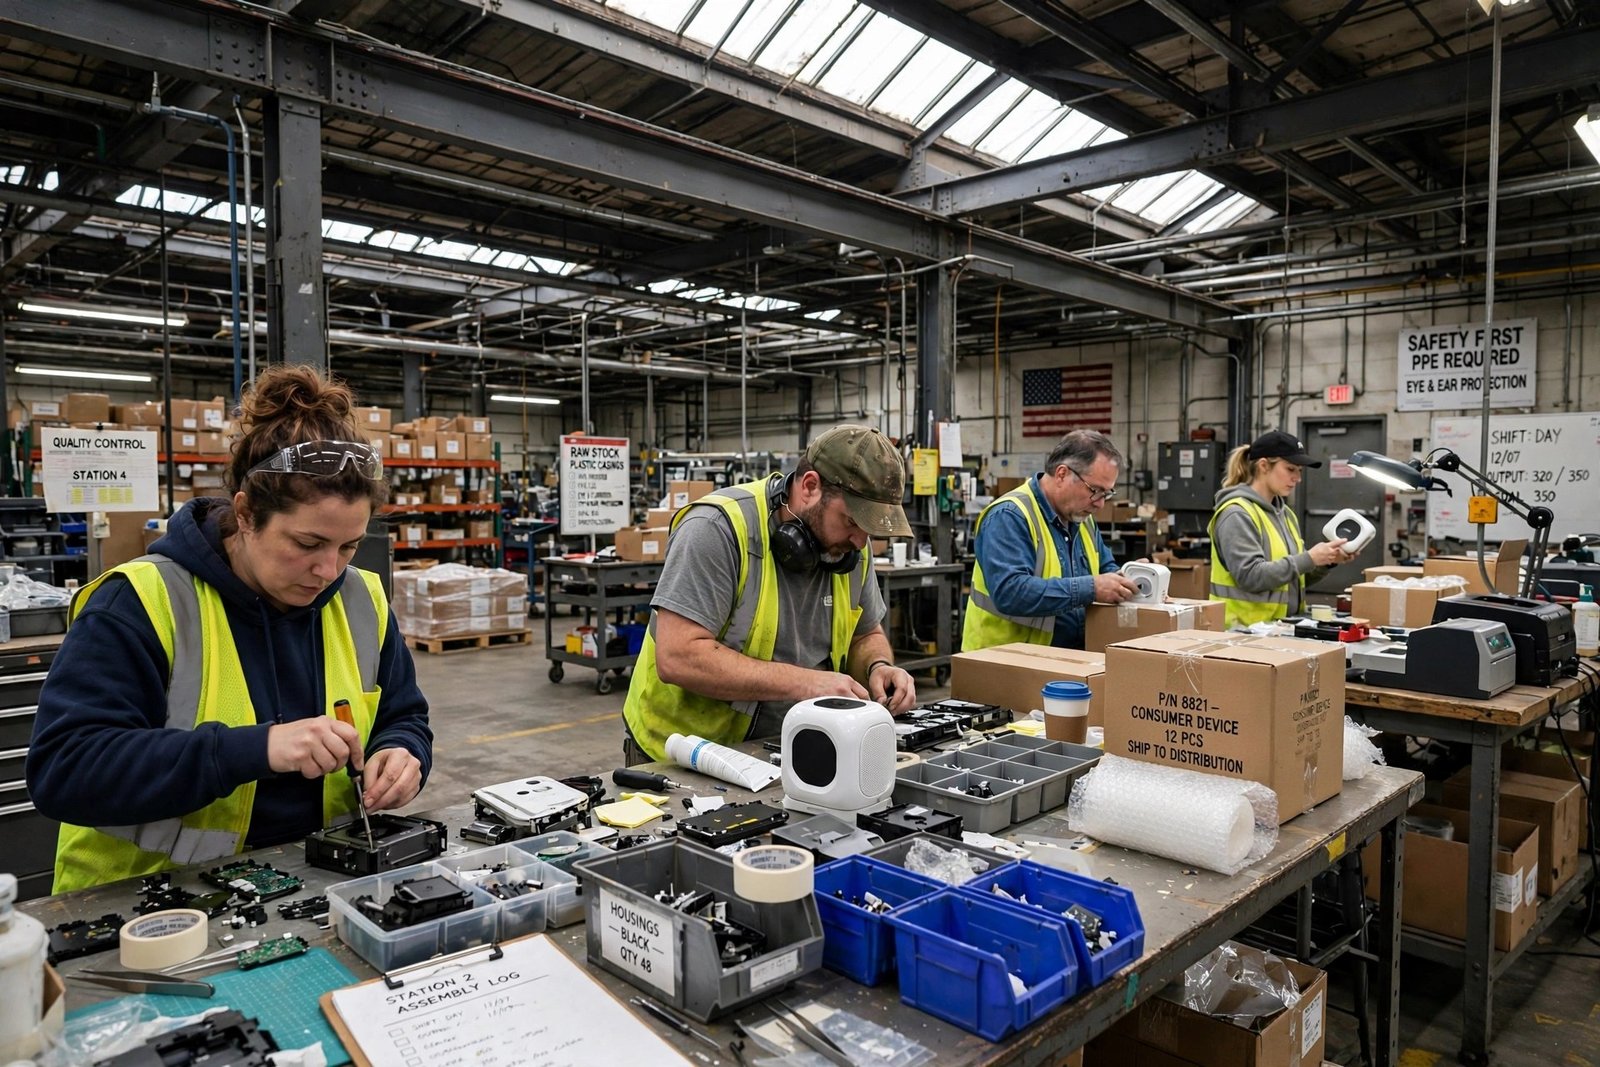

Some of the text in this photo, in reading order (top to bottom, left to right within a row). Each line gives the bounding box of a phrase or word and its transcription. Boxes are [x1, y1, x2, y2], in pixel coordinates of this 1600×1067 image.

[1408, 326, 1524, 352] SAFETY FRST
[1412, 348, 1520, 371] PPE REQURED
[1329, 386, 1349, 402] EXIT
[1406, 380, 1425, 394] EYE
[1427, 379, 1435, 392] &
[1438, 378, 1458, 392] EAR
[53, 437, 146, 449] QUALITY CONTROL
[1491, 428, 1562, 445] SHIFT: DAY
[571, 446, 620, 458] RAW STOCK
[1491, 450, 1520, 467] 12/07
[570, 460, 596, 469] PLASTIC
[73, 470, 127, 480] STATION 4
[1532, 470, 1553, 482] 320
[1568, 469, 1590, 482] 350
[1534, 489, 1556, 502] 350
[1159, 692, 1178, 708] P/N
[1181, 696, 1208, 712] 8821
[1131, 705, 1239, 735] CONSUMER DEVICE
[1165, 729, 1204, 748] 12 PCS
[1128, 739, 1243, 774] SHIP TO DISTRIBUTION
[611, 901, 660, 937] HOUSINGS
[621, 926, 650, 953] BLACK
[620, 946, 652, 973] QTY 48
[385, 973, 475, 1005] STATION 2
[397, 982, 480, 1014] ASSEMBLY
[487, 971, 521, 986] LOG
